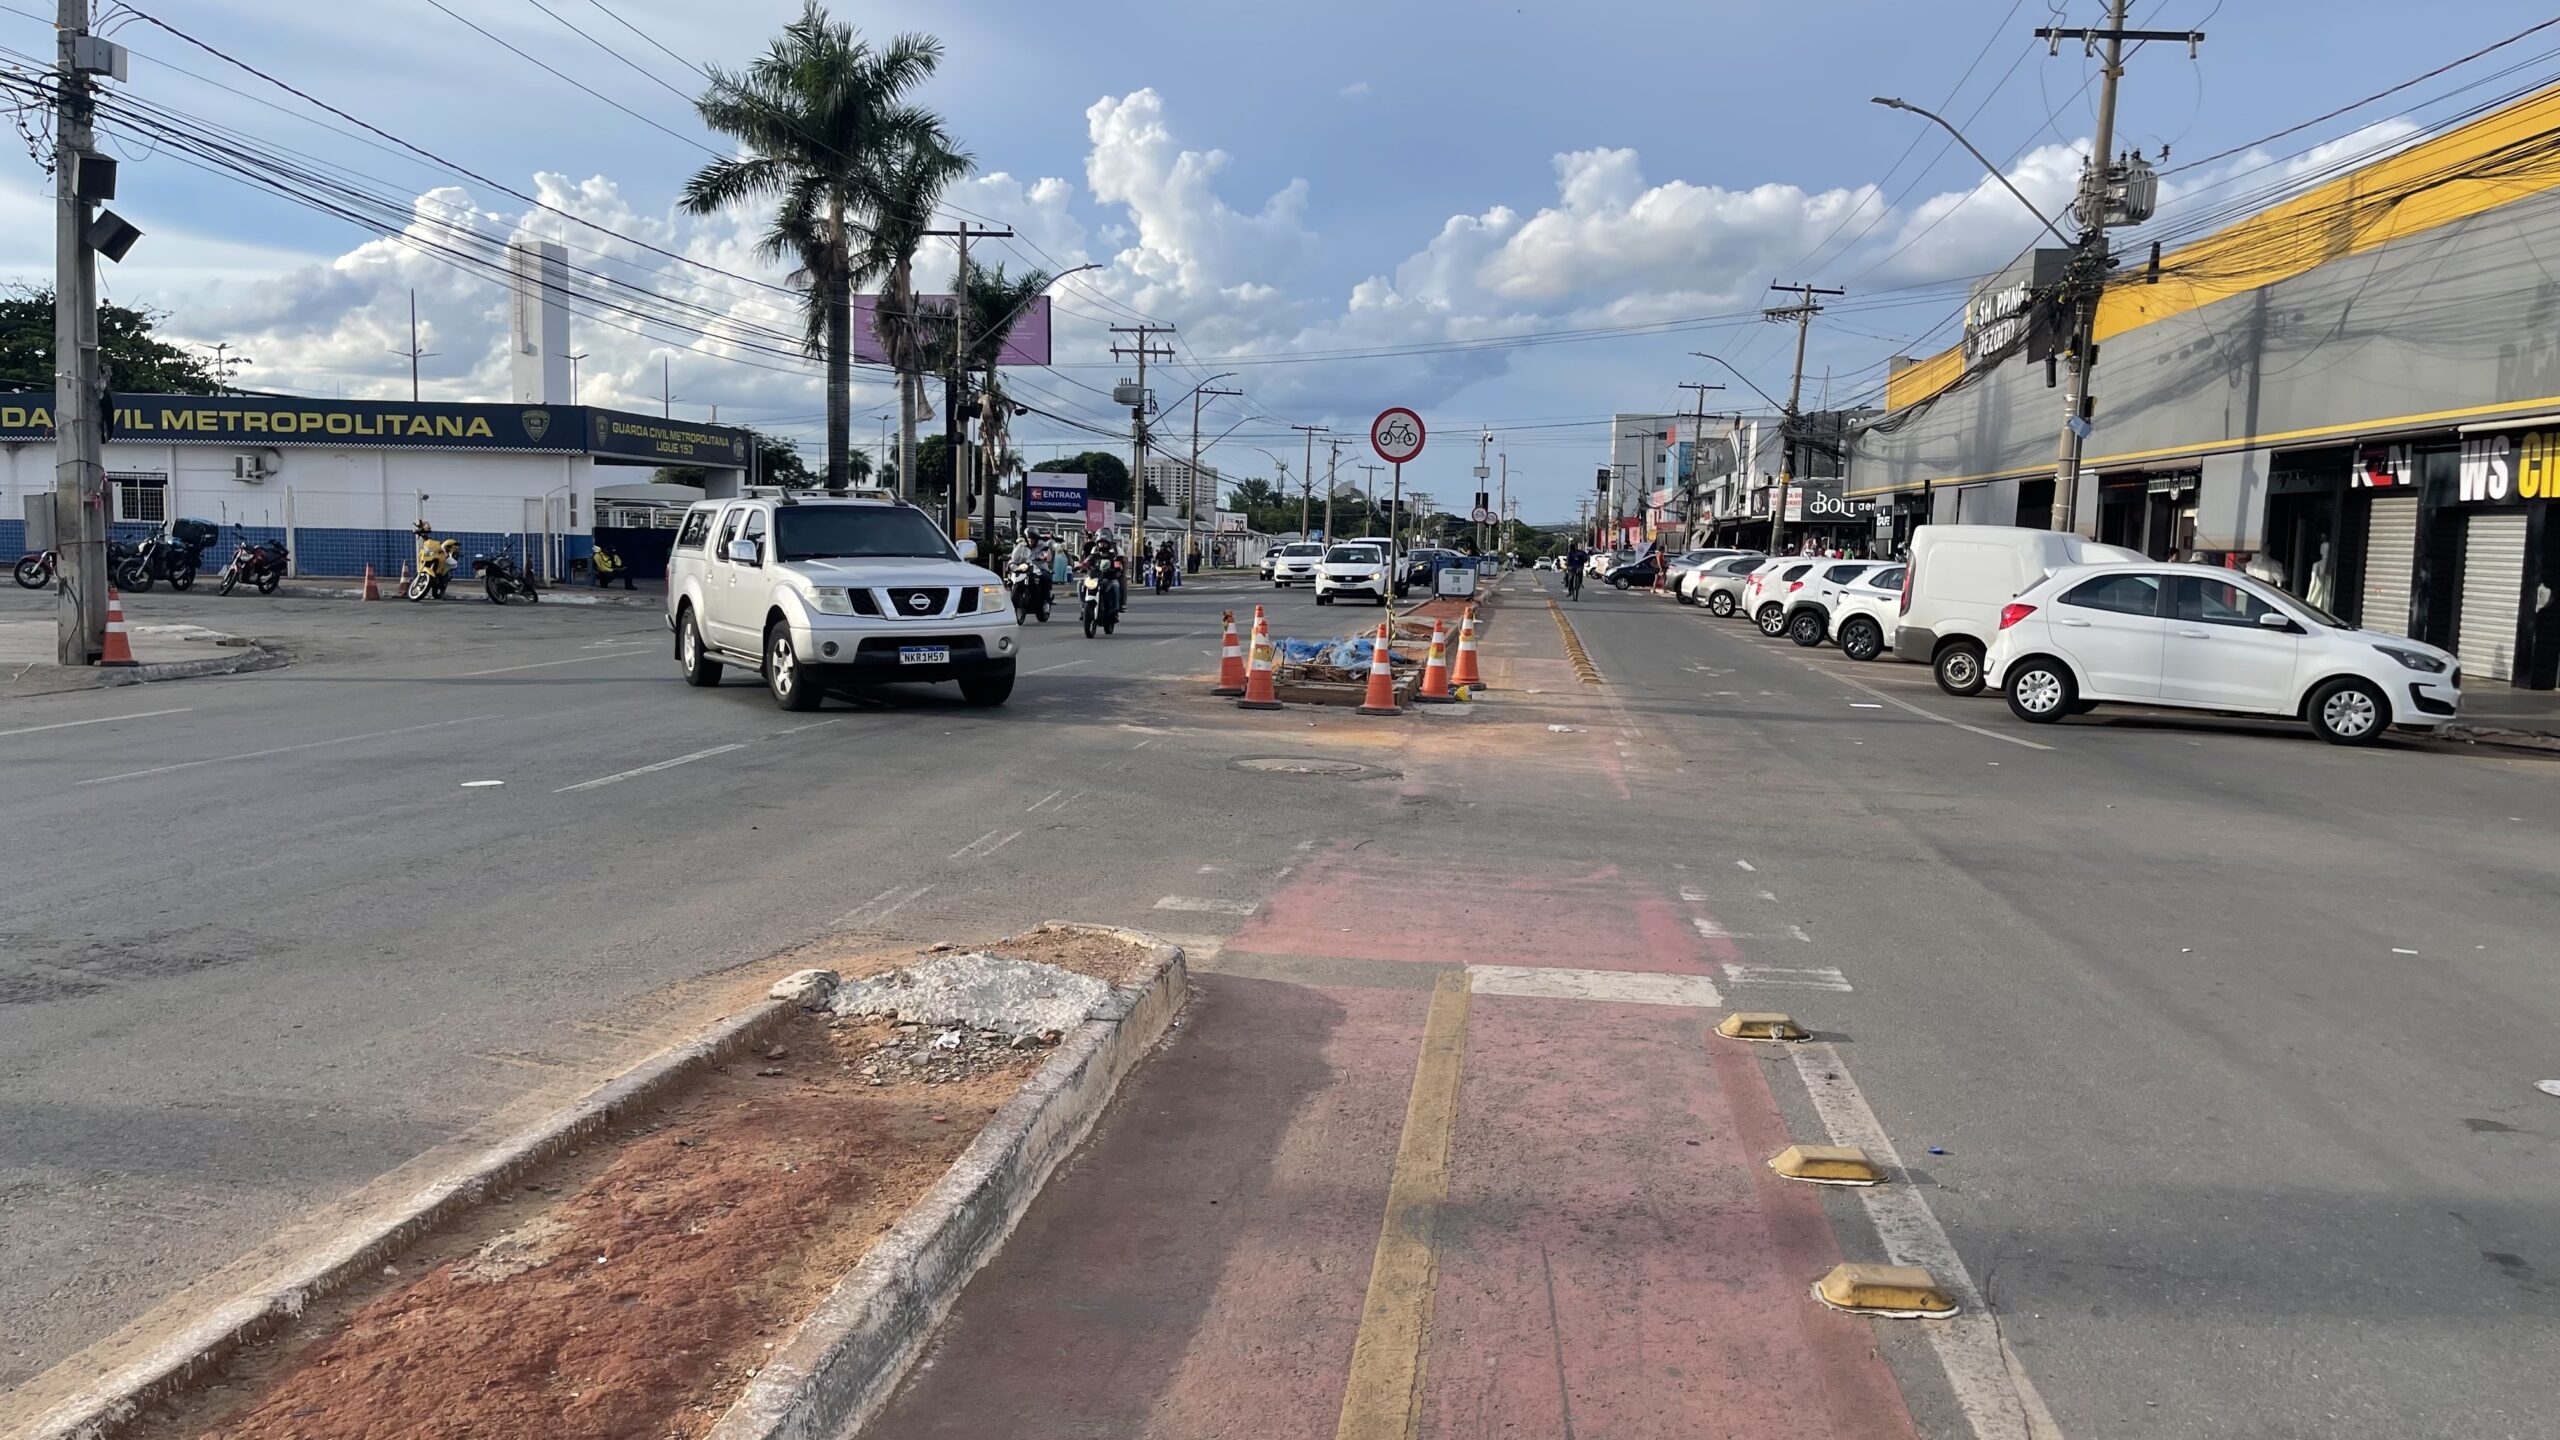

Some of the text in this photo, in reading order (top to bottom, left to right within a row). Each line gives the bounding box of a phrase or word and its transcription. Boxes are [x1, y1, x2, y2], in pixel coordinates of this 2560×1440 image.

[161, 409, 494, 438] METROPOLITANA
[612, 422, 649, 437] GUARDA
[649, 427, 669, 440] CIVIL
[669, 430, 729, 447] METROPOLITANA
[656, 442, 694, 455] LIGUE 153
[2459, 435, 2510, 501] WS
[1043, 490, 1082, 499] ENTRADA
[904, 652, 945, 663] NKR1H59
